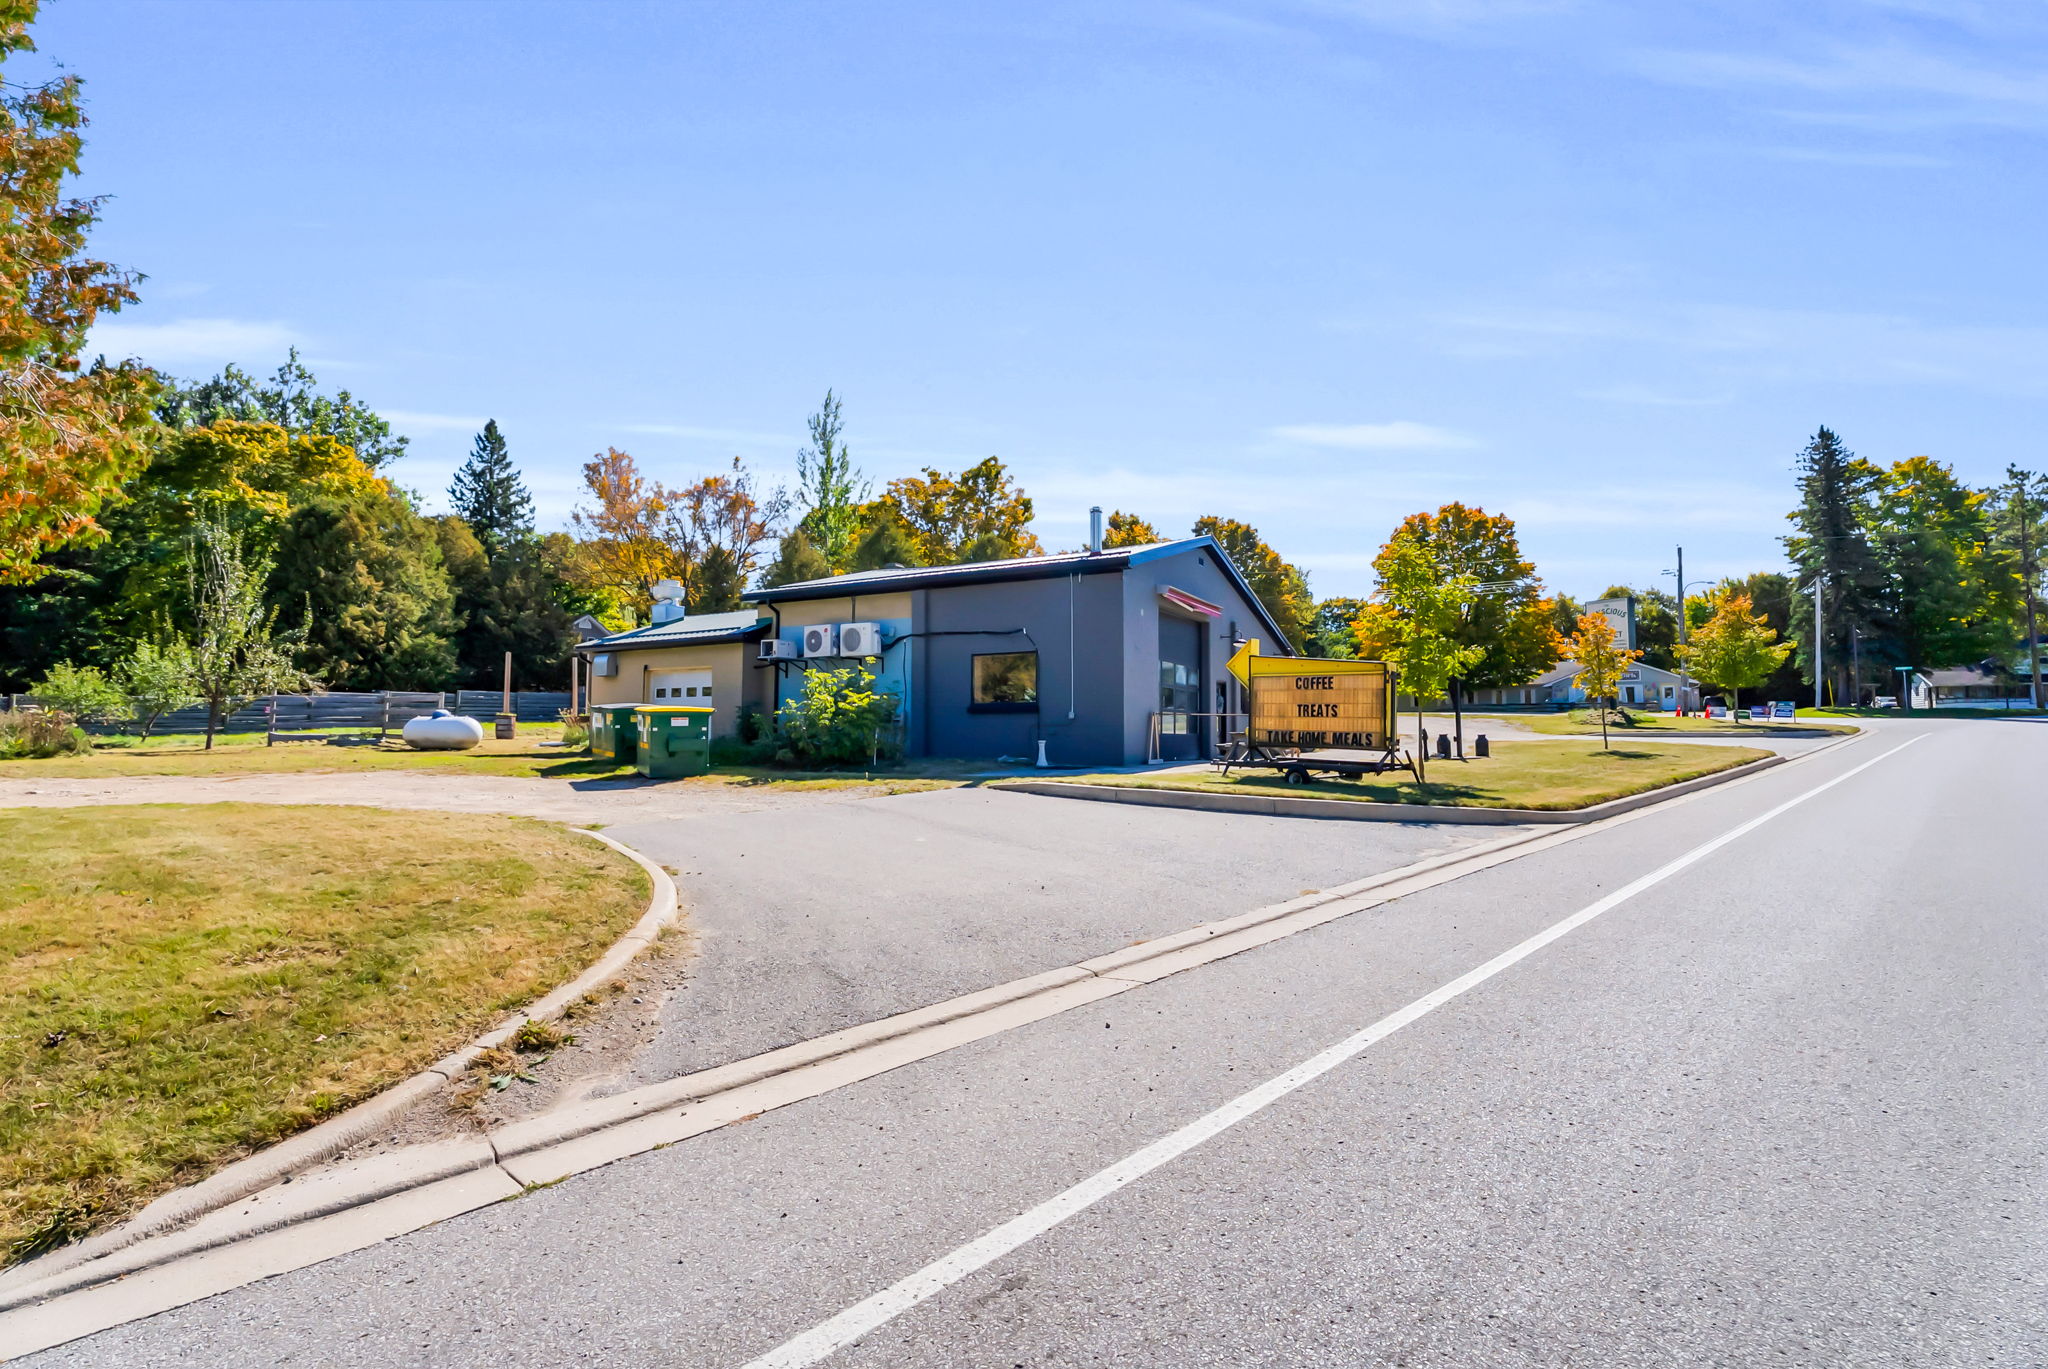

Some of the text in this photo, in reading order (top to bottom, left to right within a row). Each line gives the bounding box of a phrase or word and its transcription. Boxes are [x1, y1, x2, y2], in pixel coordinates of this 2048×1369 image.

[1295, 676, 1334, 690] COFFEE
[1297, 704, 1338, 717] TREATS
[1267, 730, 1373, 746] TAKE HOME MEALS
